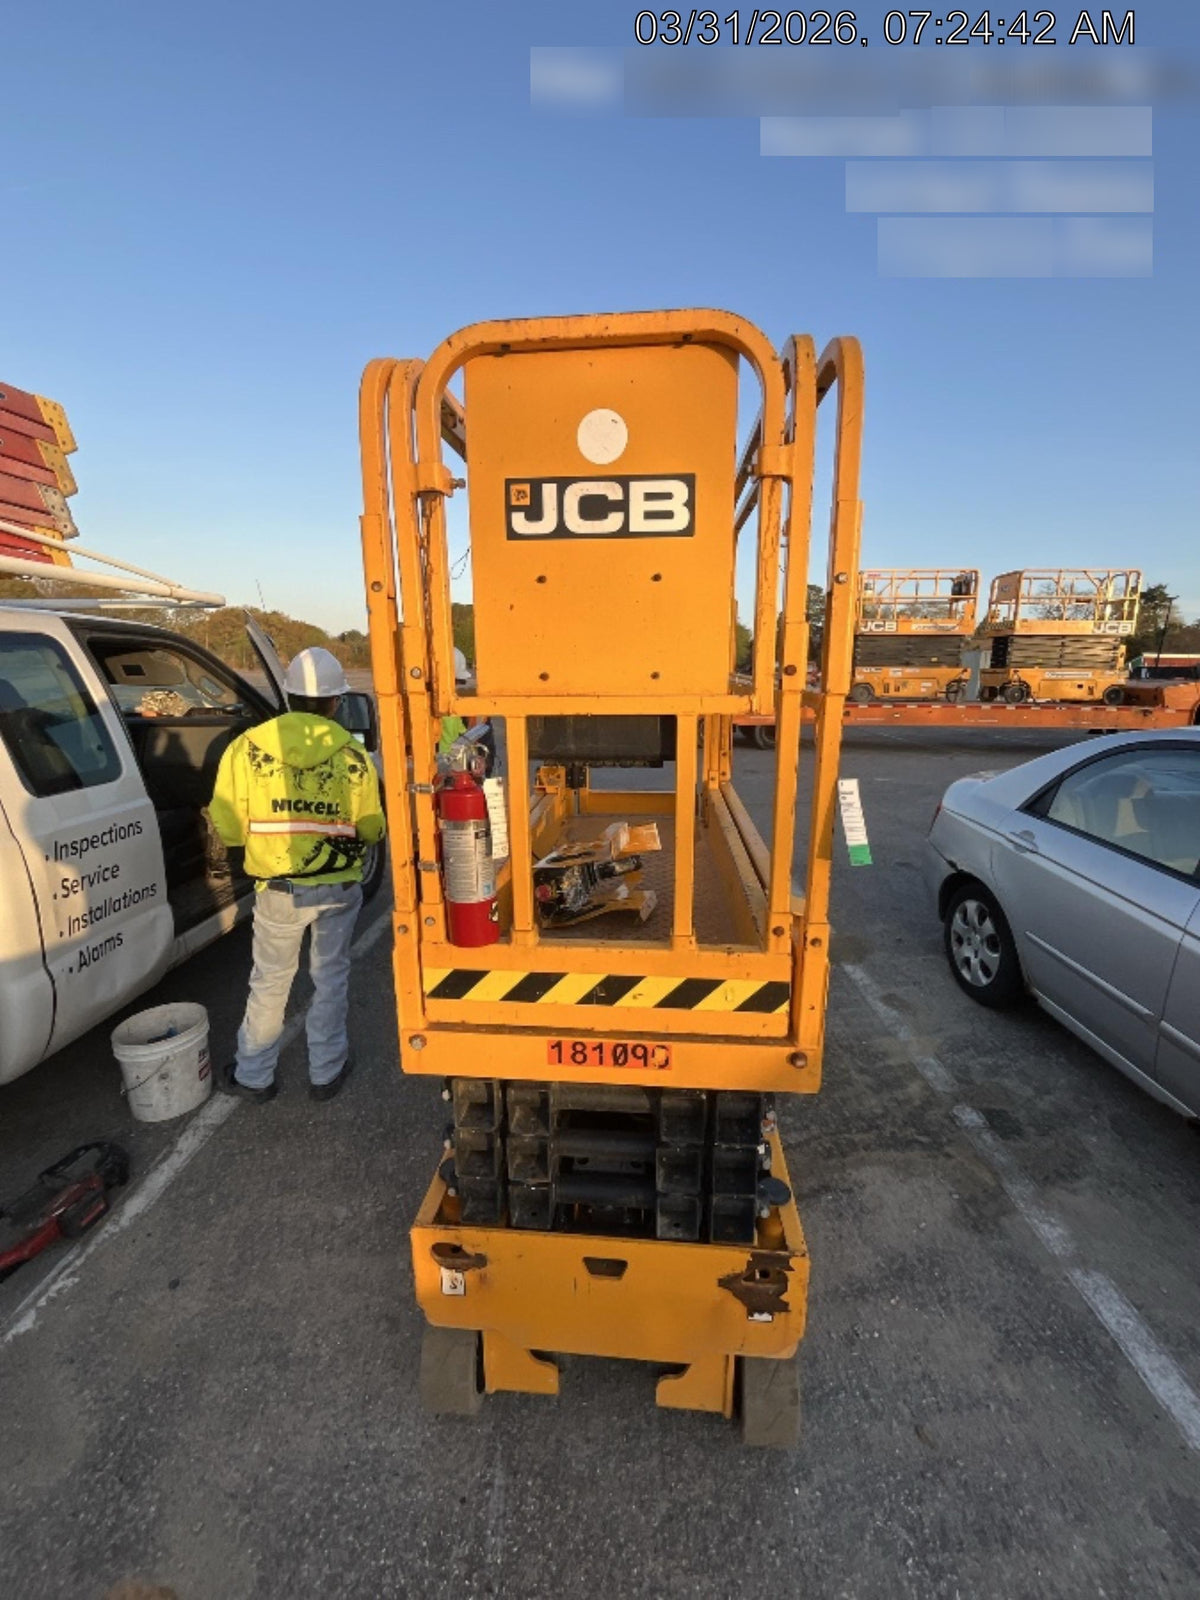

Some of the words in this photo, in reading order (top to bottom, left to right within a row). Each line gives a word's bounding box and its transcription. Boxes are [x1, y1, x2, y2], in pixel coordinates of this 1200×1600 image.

[511, 479, 690, 535] JCB
[861, 621, 897, 632] JCB
[1094, 622, 1131, 633] JCB
[54, 820, 143, 862] Inspections
[61, 863, 120, 899] Service
[68, 882, 157, 937] Installations
[77, 932, 124, 973] Alarms
